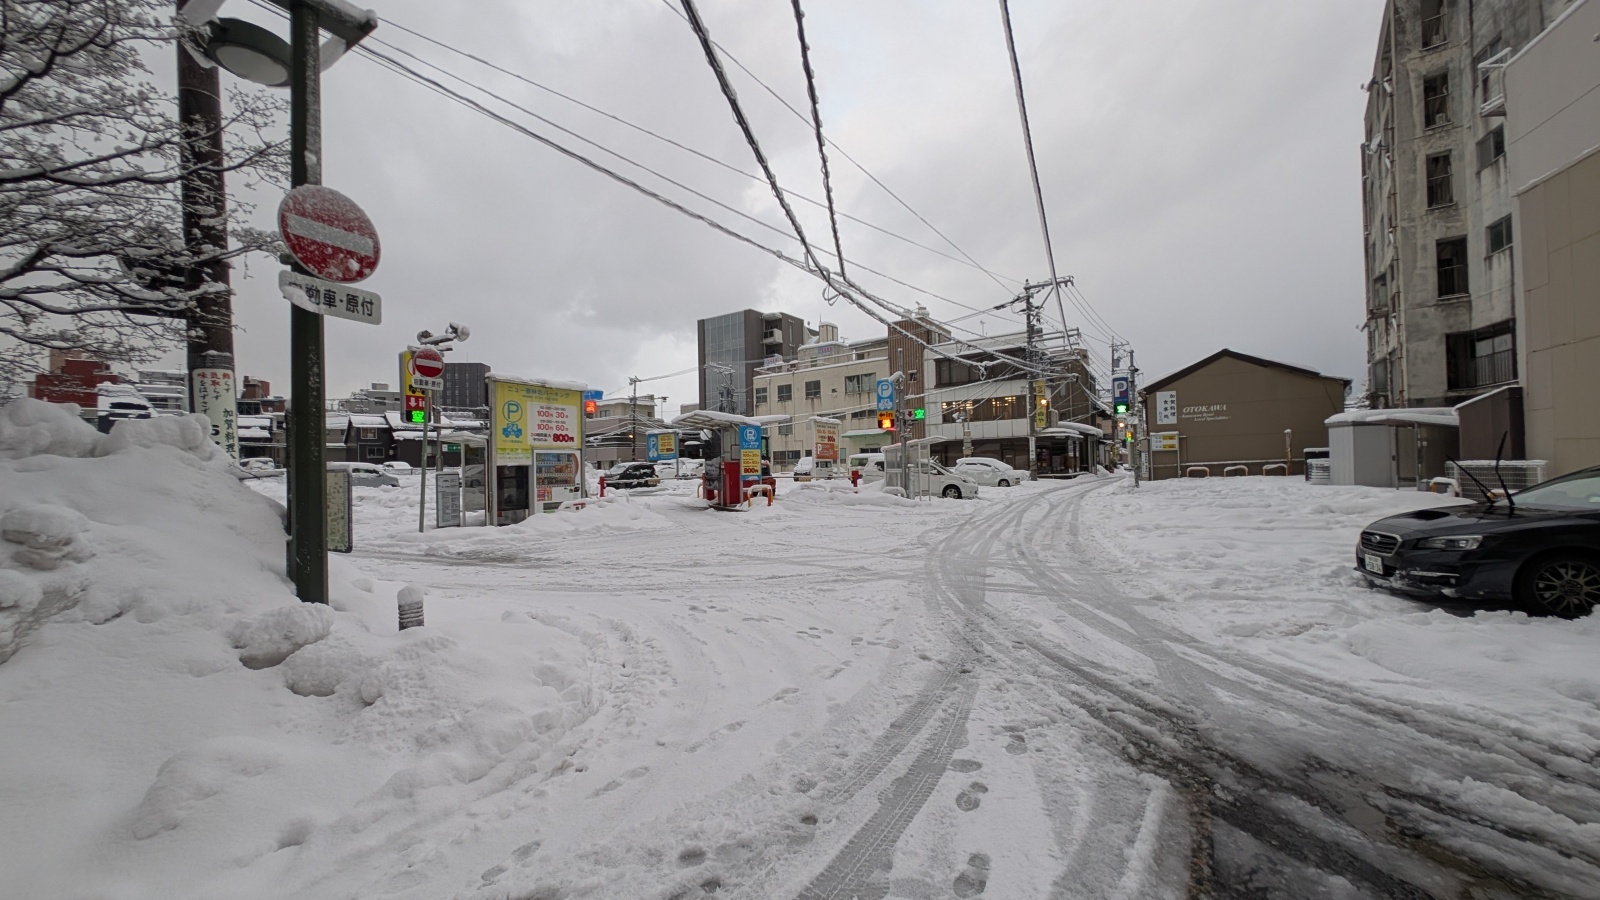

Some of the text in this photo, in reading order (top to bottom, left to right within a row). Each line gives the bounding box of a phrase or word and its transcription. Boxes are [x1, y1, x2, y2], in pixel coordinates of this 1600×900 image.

[288, 281, 374, 317] 動車・原付
[880, 384, 890, 396] P
[1114, 380, 1127, 397] P
[507, 403, 520, 420] P
[1182, 404, 1227, 413] OTOKAWA
[507, 424, 518, 432] 24
[552, 433, 575, 443] 800円
